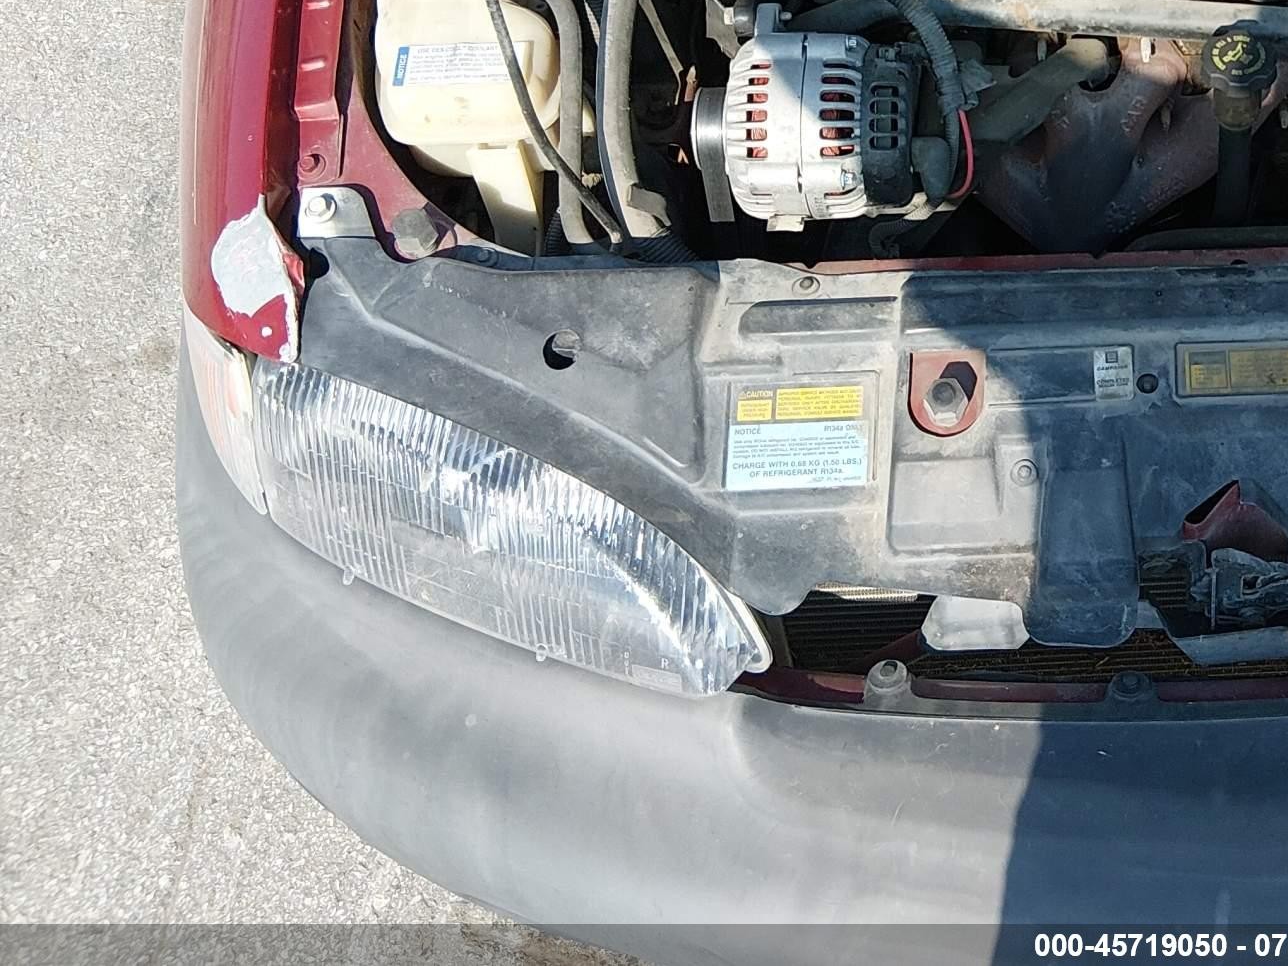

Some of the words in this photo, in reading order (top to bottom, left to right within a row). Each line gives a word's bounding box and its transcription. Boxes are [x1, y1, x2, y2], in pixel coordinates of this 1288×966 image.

[746, 390, 773, 398] CAUTION
[732, 462, 766, 470] CHARGE
[842, 458, 862, 466] LBS.)
[763, 468, 818, 477] REFRIGERANT
